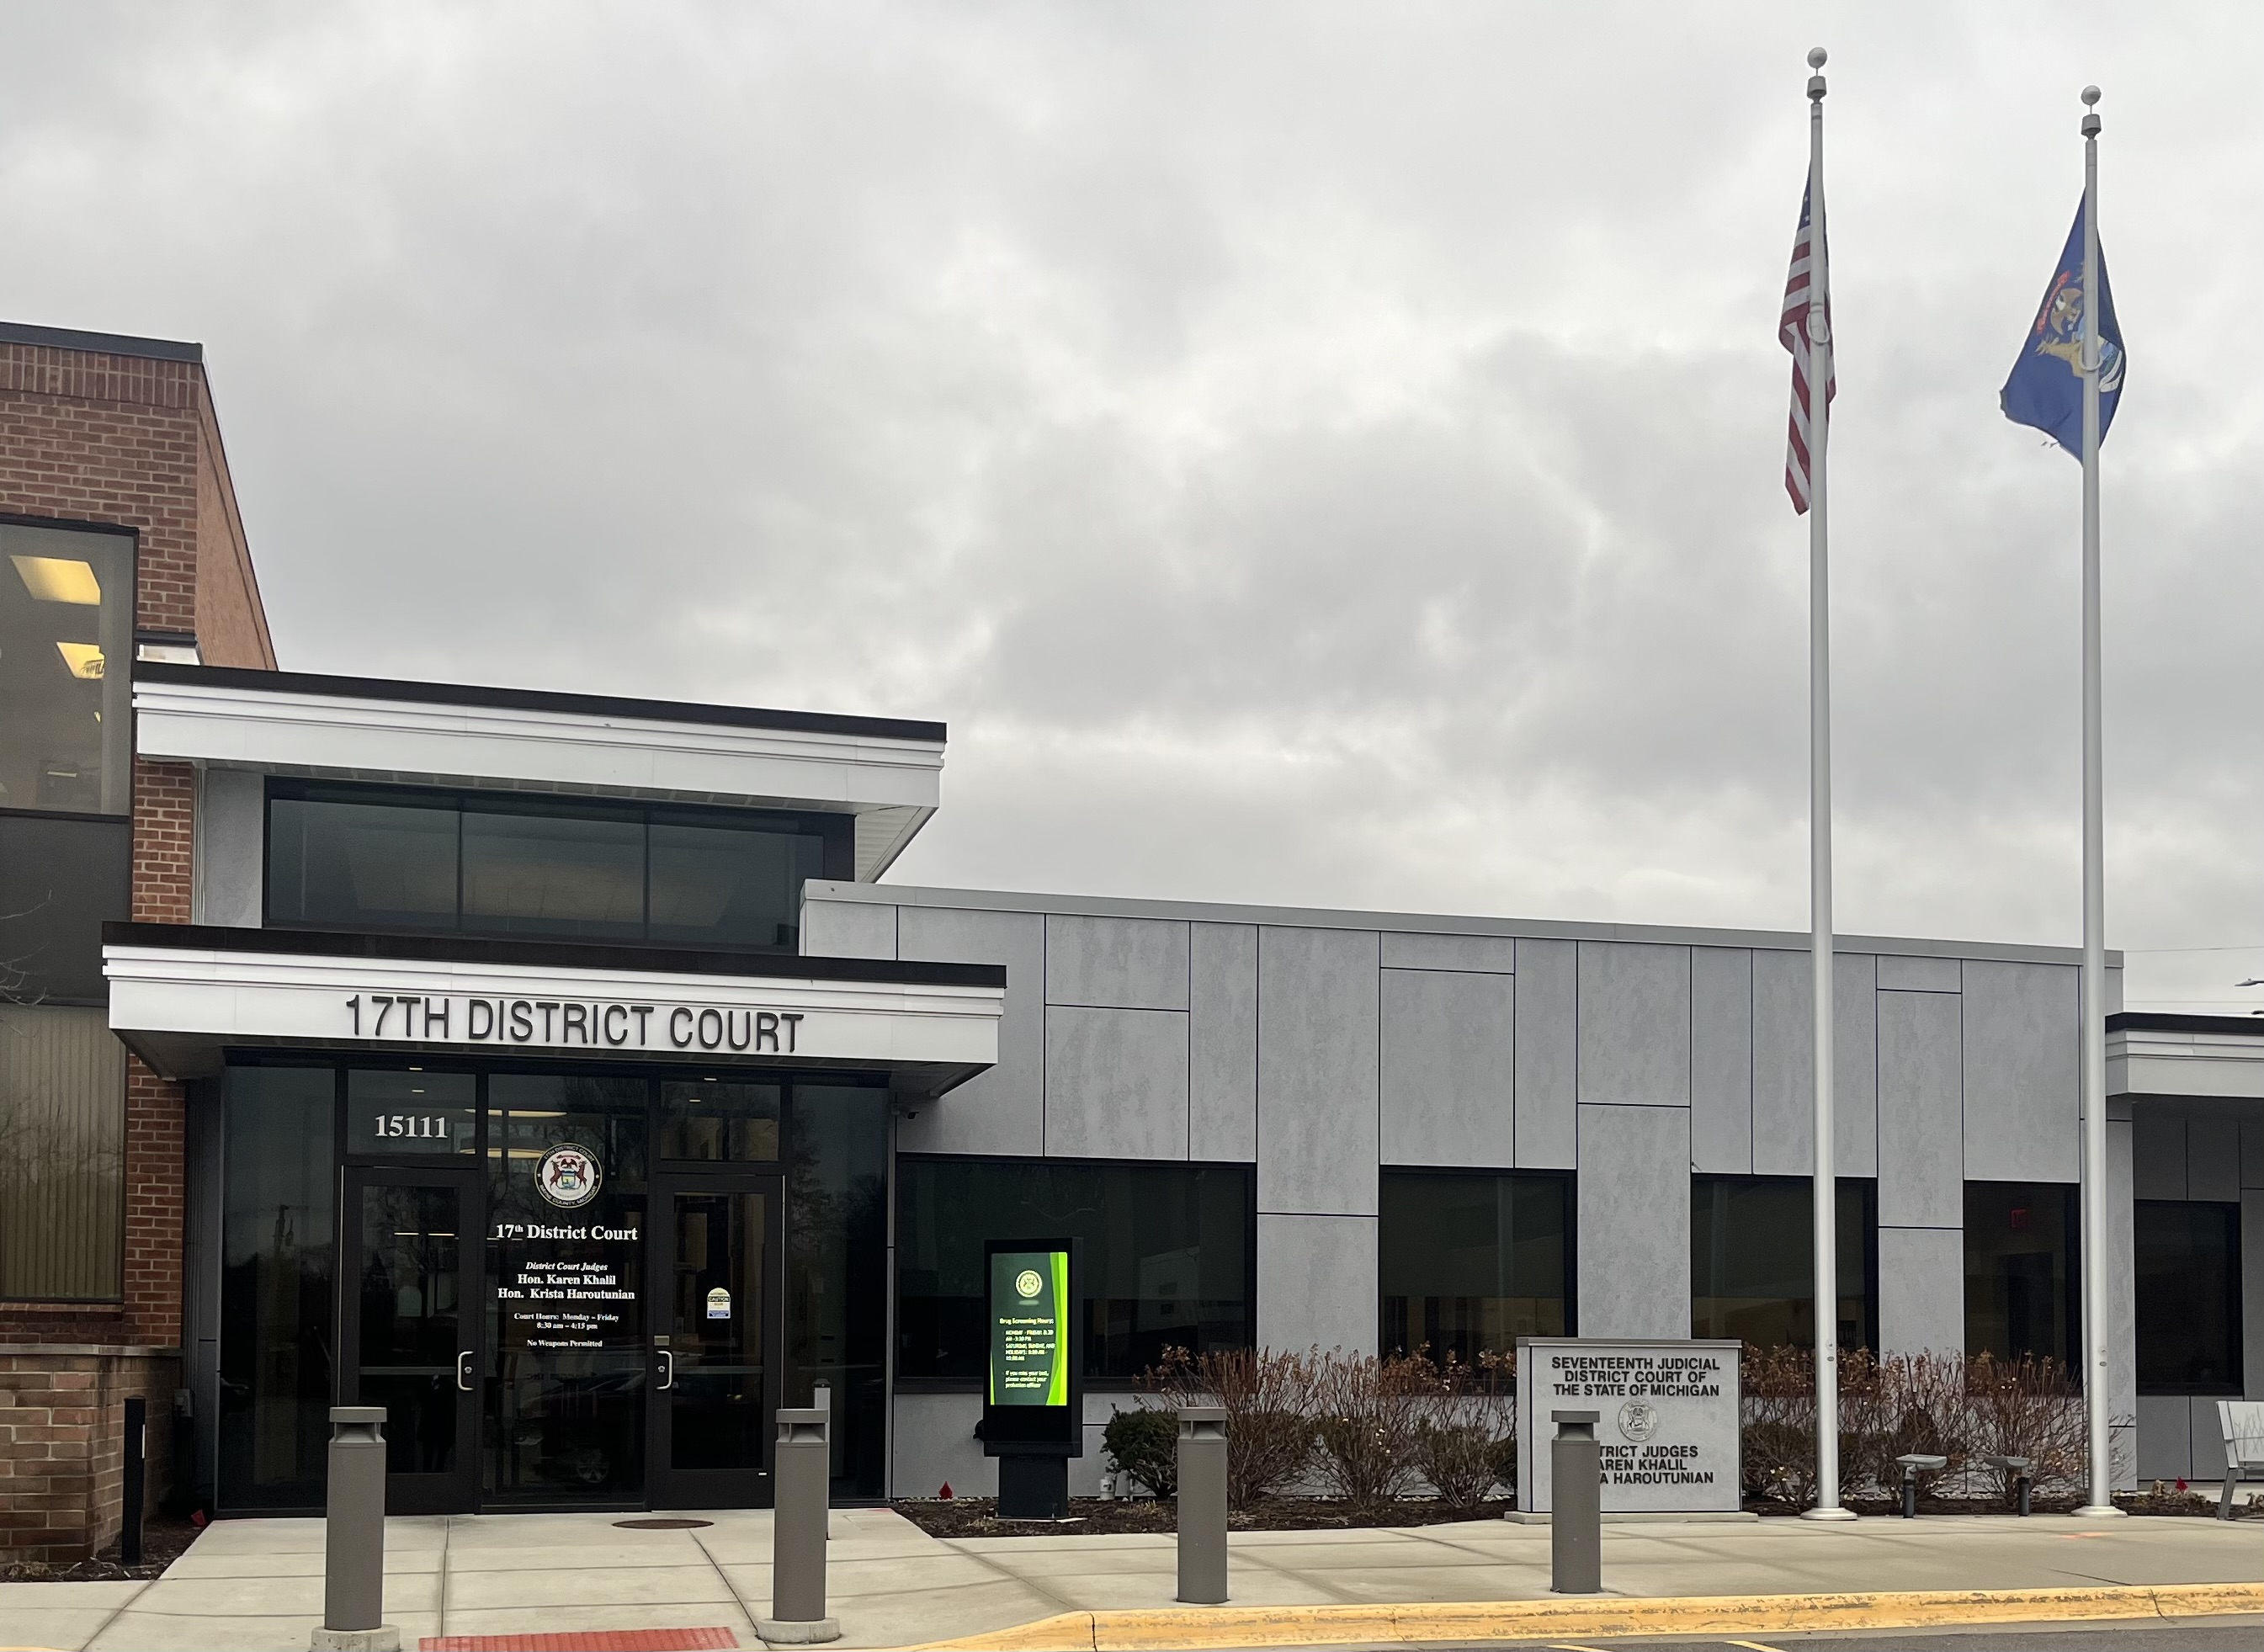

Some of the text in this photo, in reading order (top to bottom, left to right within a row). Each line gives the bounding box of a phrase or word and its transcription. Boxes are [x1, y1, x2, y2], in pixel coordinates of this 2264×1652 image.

[346, 994, 805, 1053] 17TH DISTRICT COURT
[375, 1115, 448, 1139] 15111
[579, 1148, 595, 1161] COURT
[496, 1224, 638, 1240] 17th District Court
[581, 1262, 609, 1272] Judges
[518, 1274, 616, 1285] Hon. Karen Khalil
[497, 1288, 635, 1299] Hon. Krista Haroutunian
[562, 1313, 590, 1321] Monday
[597, 1314, 619, 1322] Friday
[538, 1339, 569, 1347] Weapons
[1551, 1357, 1720, 1370] SEVENTEENTH JUDICIAL
[1565, 1370, 1707, 1383] DISTRICT COURT OF
[1553, 1384, 1719, 1397] THE STATE OF MICHIGAN
[1599, 1445, 1698, 1458] TRICT JUDGES
[1638, 1458, 1687, 1471] KHALIL
[1613, 1472, 1714, 1485] HAROUTUNIAN
